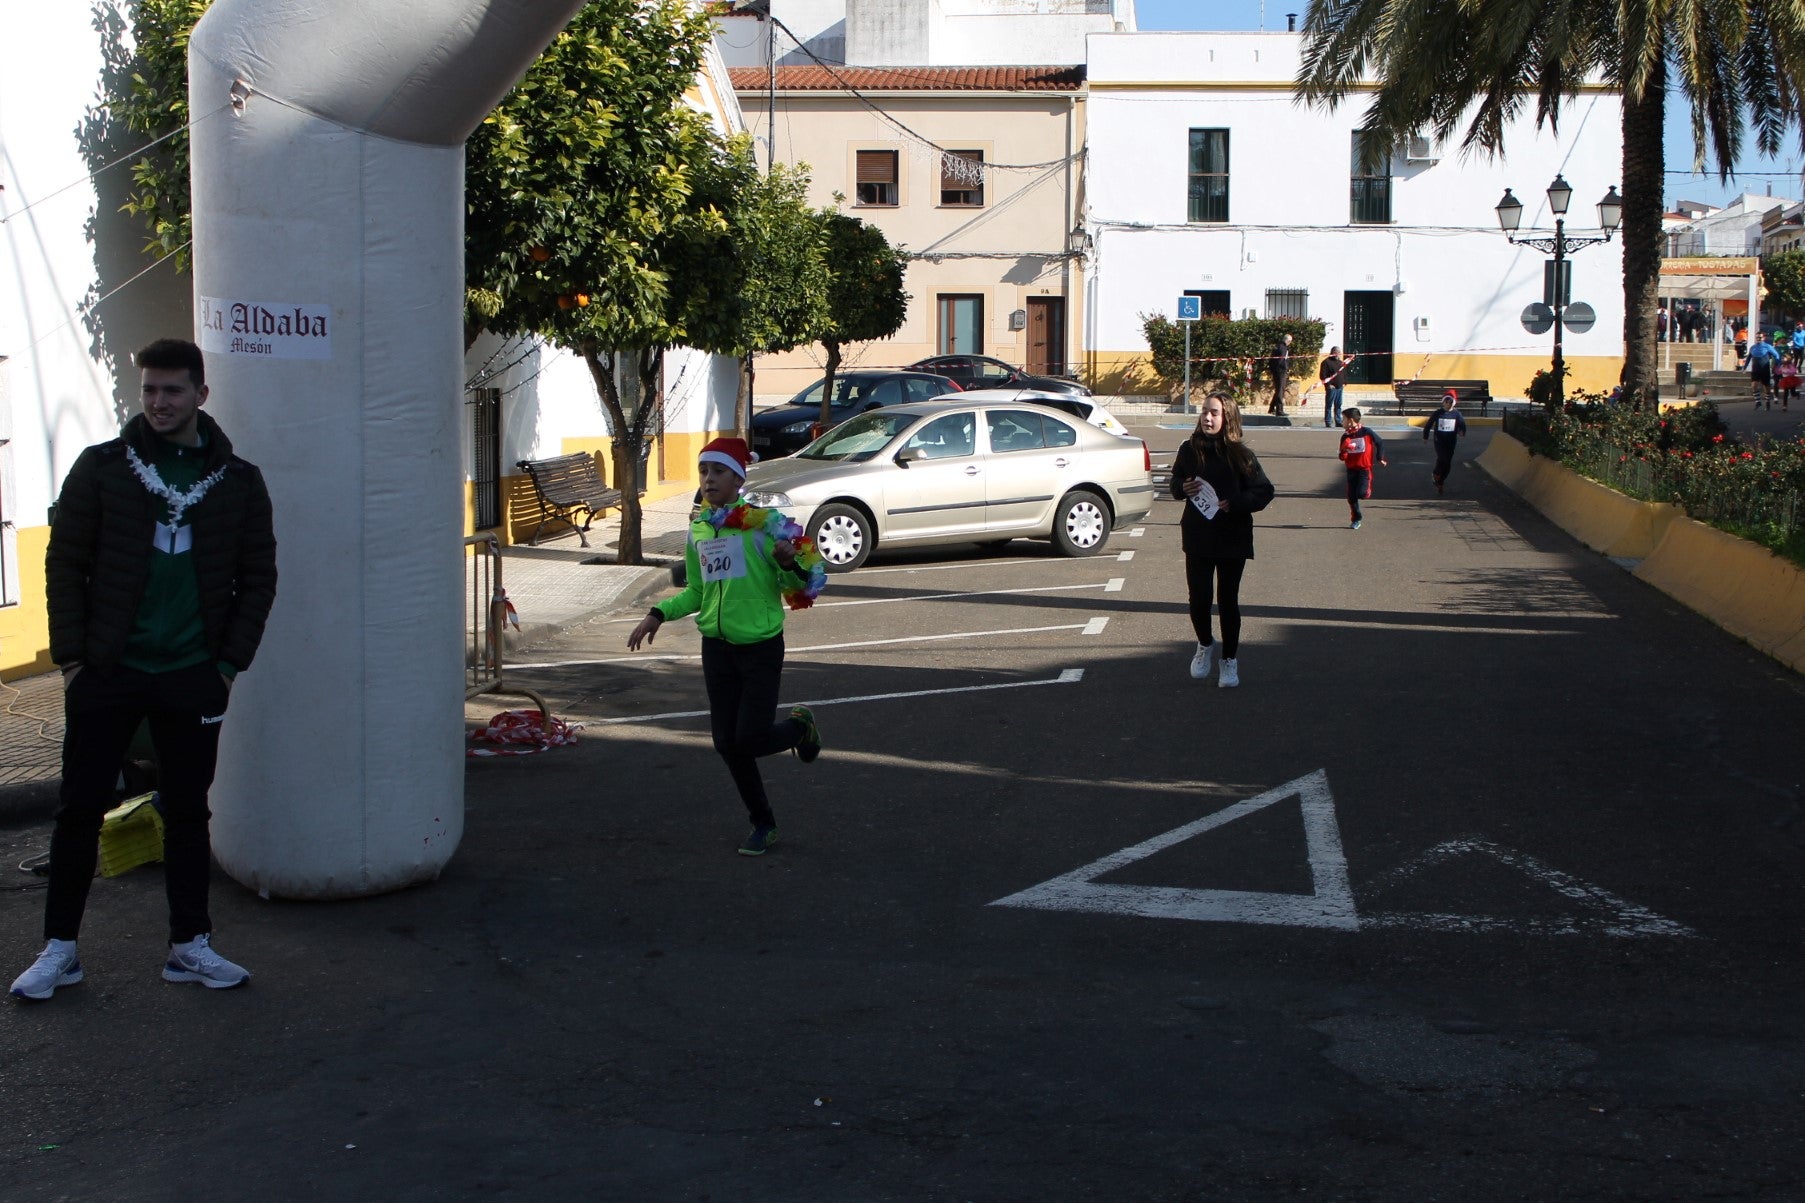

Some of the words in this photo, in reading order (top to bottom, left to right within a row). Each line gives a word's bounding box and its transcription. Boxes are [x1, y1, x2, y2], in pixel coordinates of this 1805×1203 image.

[201, 299, 224, 331] La
[230, 302, 328, 337] Aldaba
[230, 338, 272, 354] Mesón
[707, 555, 731, 574] 020
